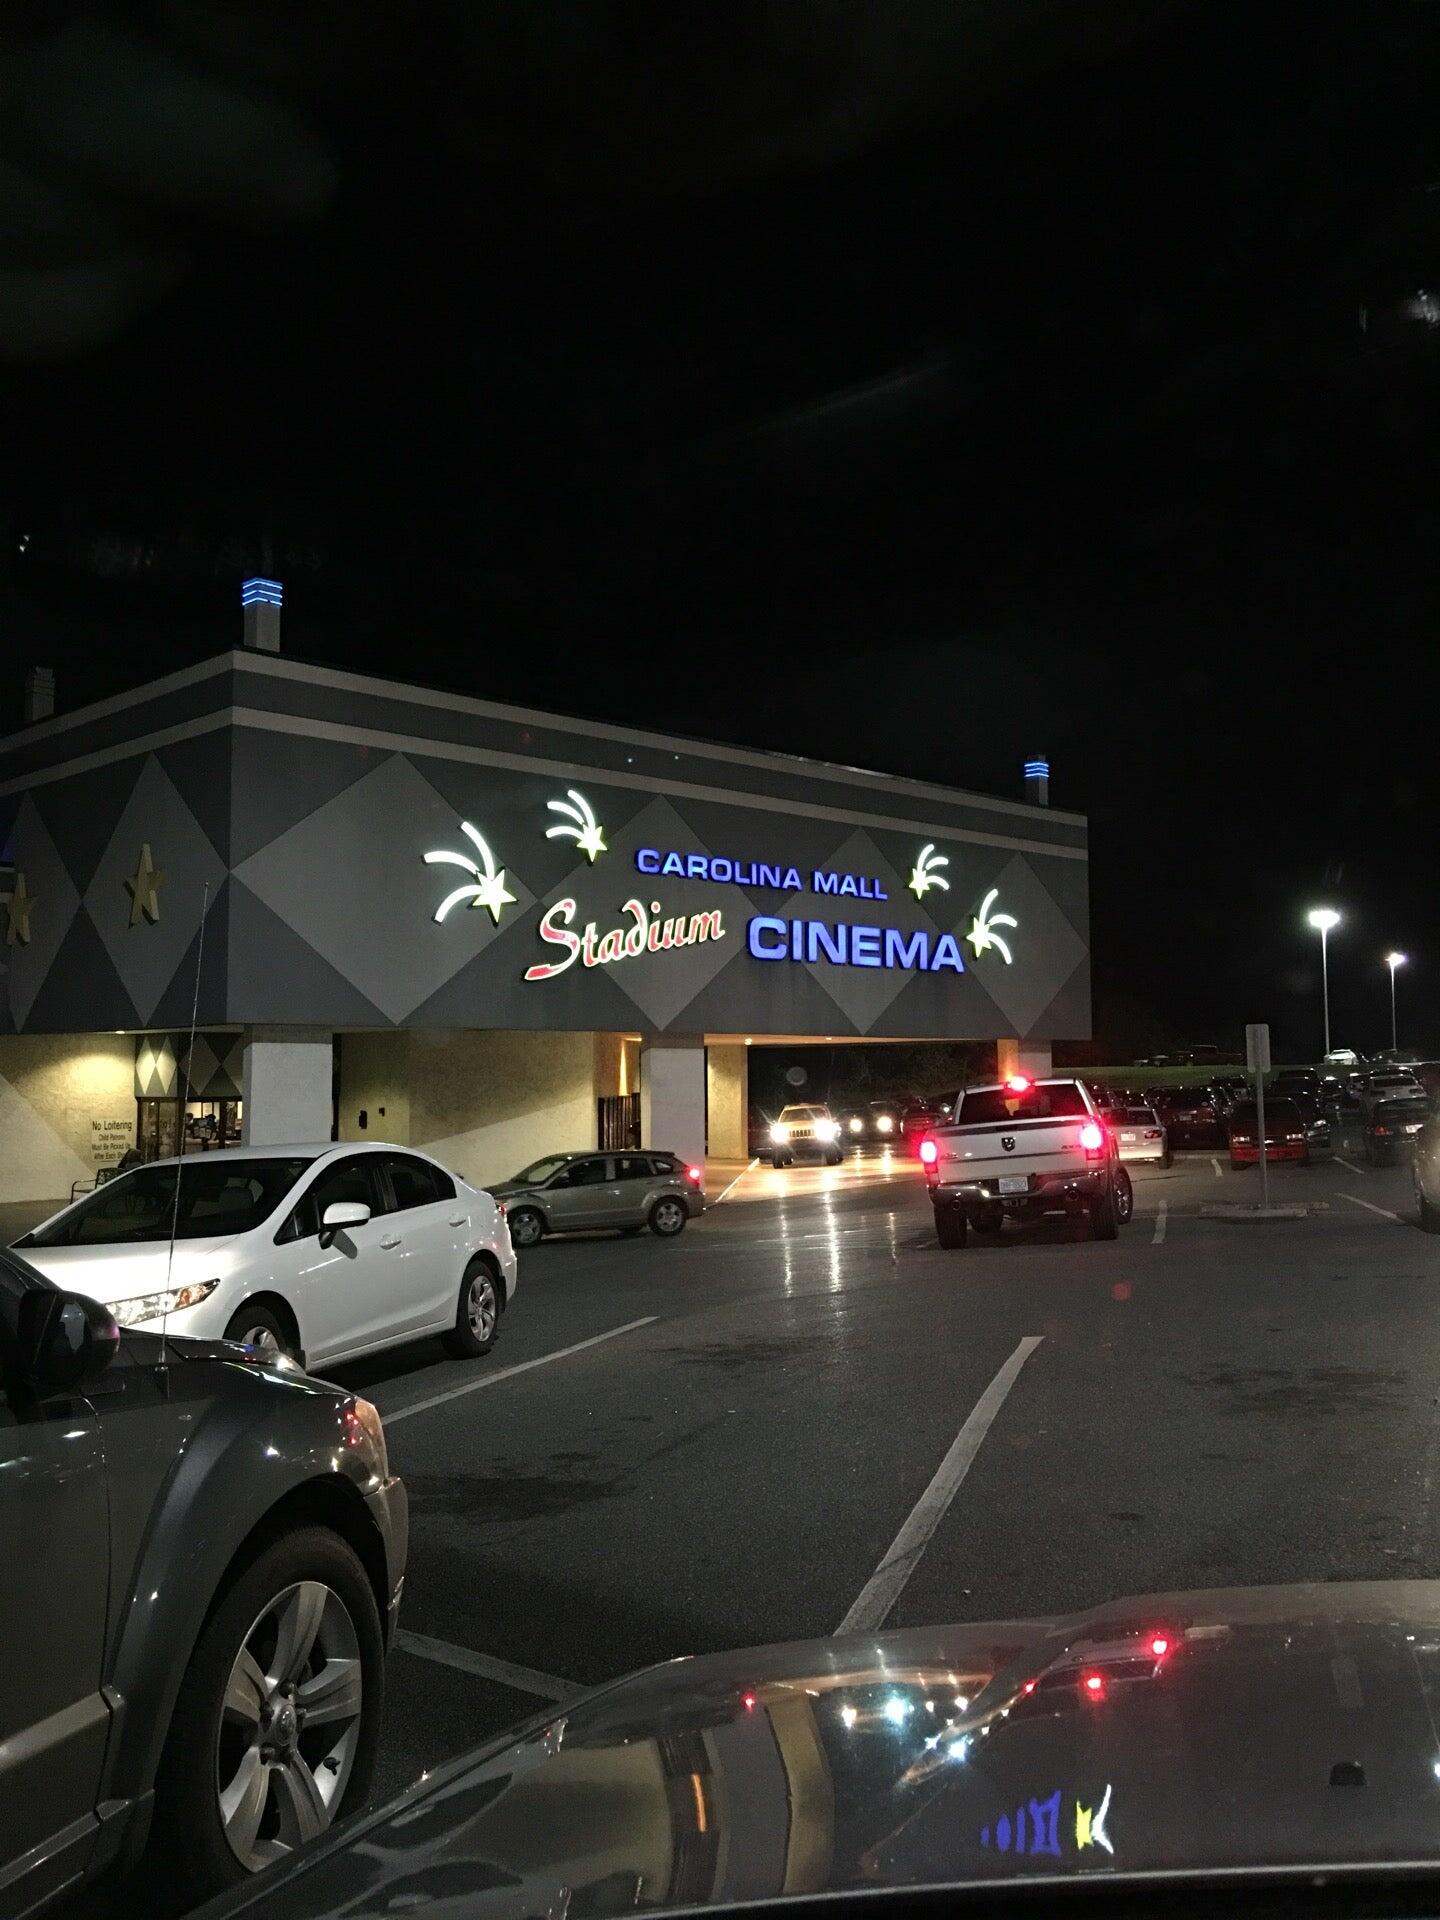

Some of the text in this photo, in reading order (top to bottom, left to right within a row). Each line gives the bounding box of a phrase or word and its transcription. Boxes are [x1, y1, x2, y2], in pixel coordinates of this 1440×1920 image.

[636, 848, 888, 901] CAROLINA MALL
[524, 898, 726, 981] Stadium
[747, 915, 965, 973] CINEMA
[92, 1120, 132, 1131] No Loitering
